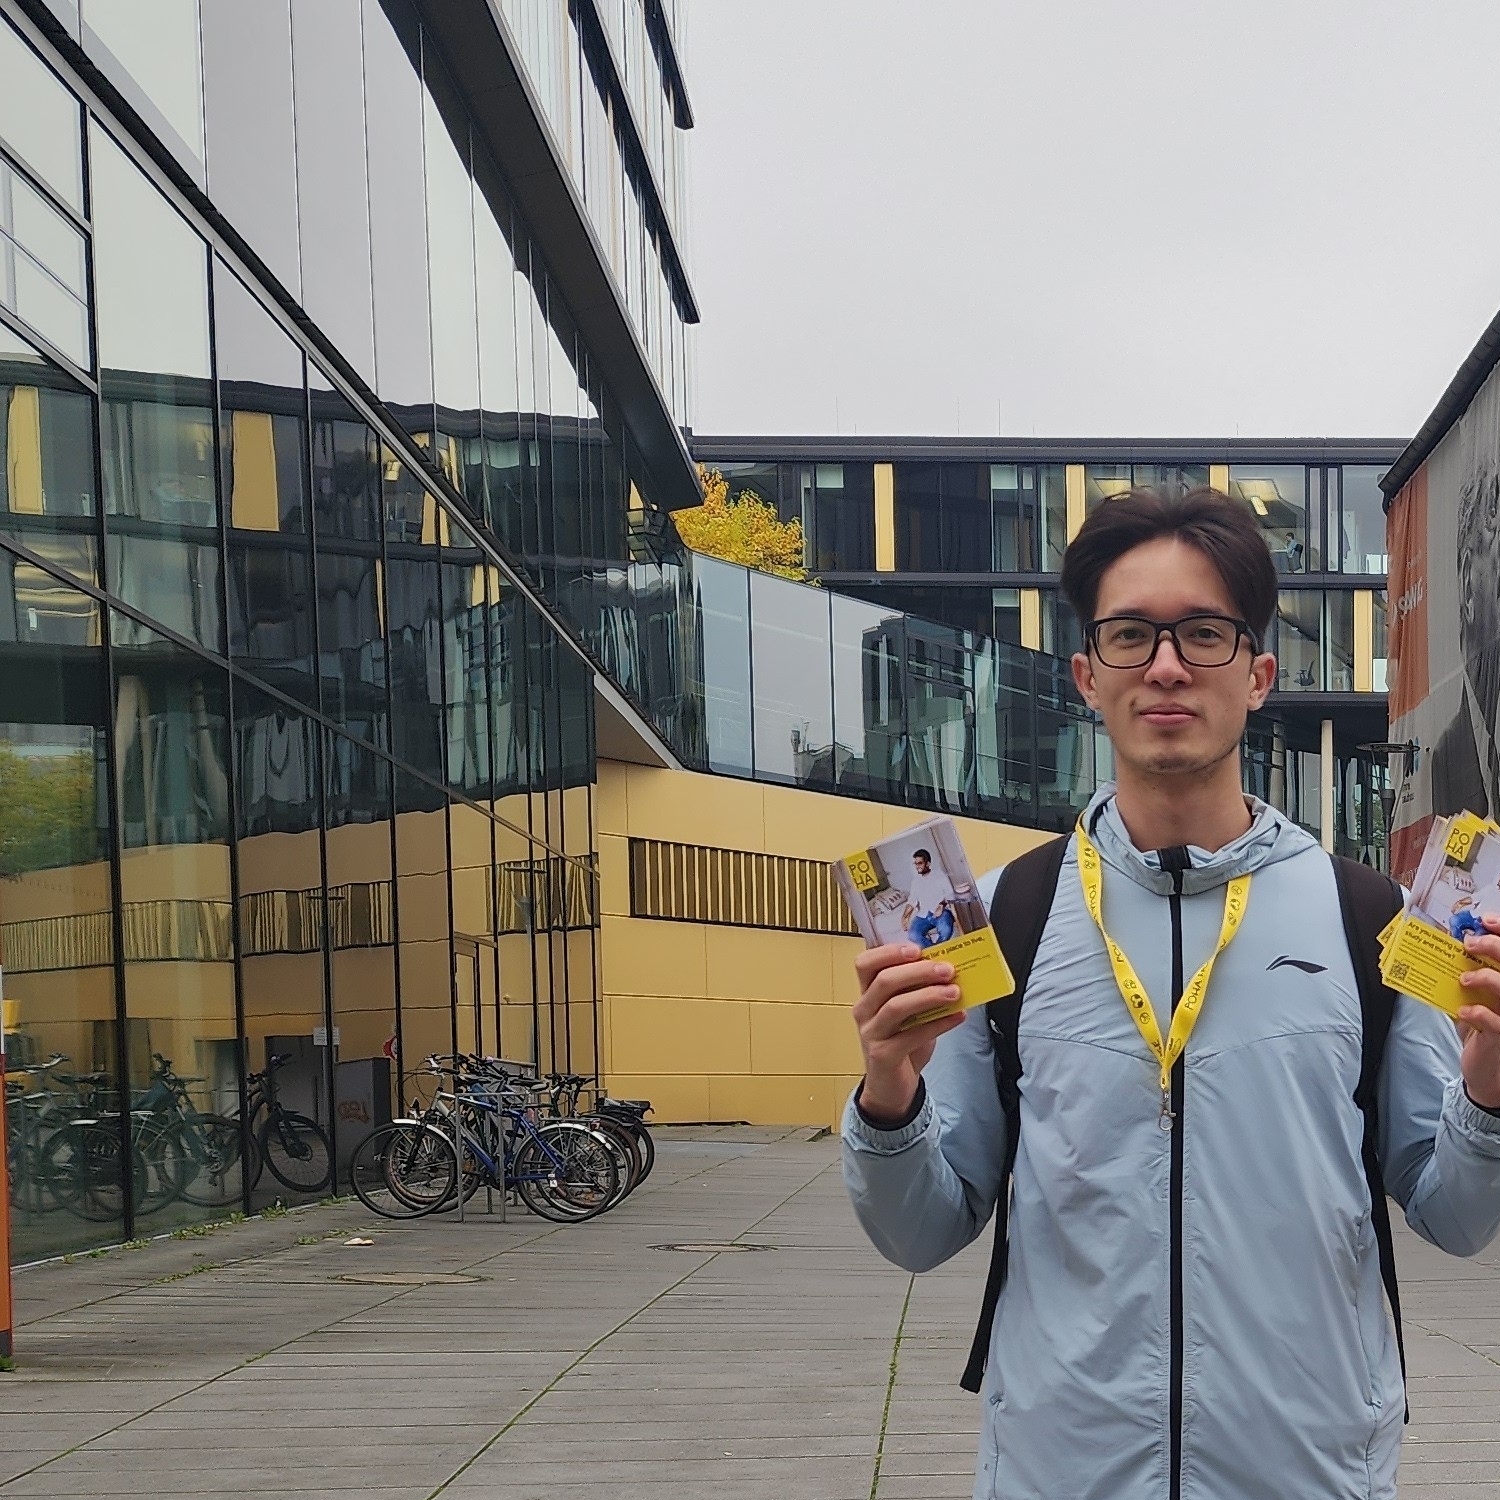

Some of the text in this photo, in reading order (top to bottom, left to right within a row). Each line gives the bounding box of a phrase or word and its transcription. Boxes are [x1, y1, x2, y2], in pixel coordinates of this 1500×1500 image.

[1450, 827, 1470, 846] PO
[1445, 842, 1464, 859] HA
[848, 860, 870, 877] PO
[853, 872, 875, 889] HA
